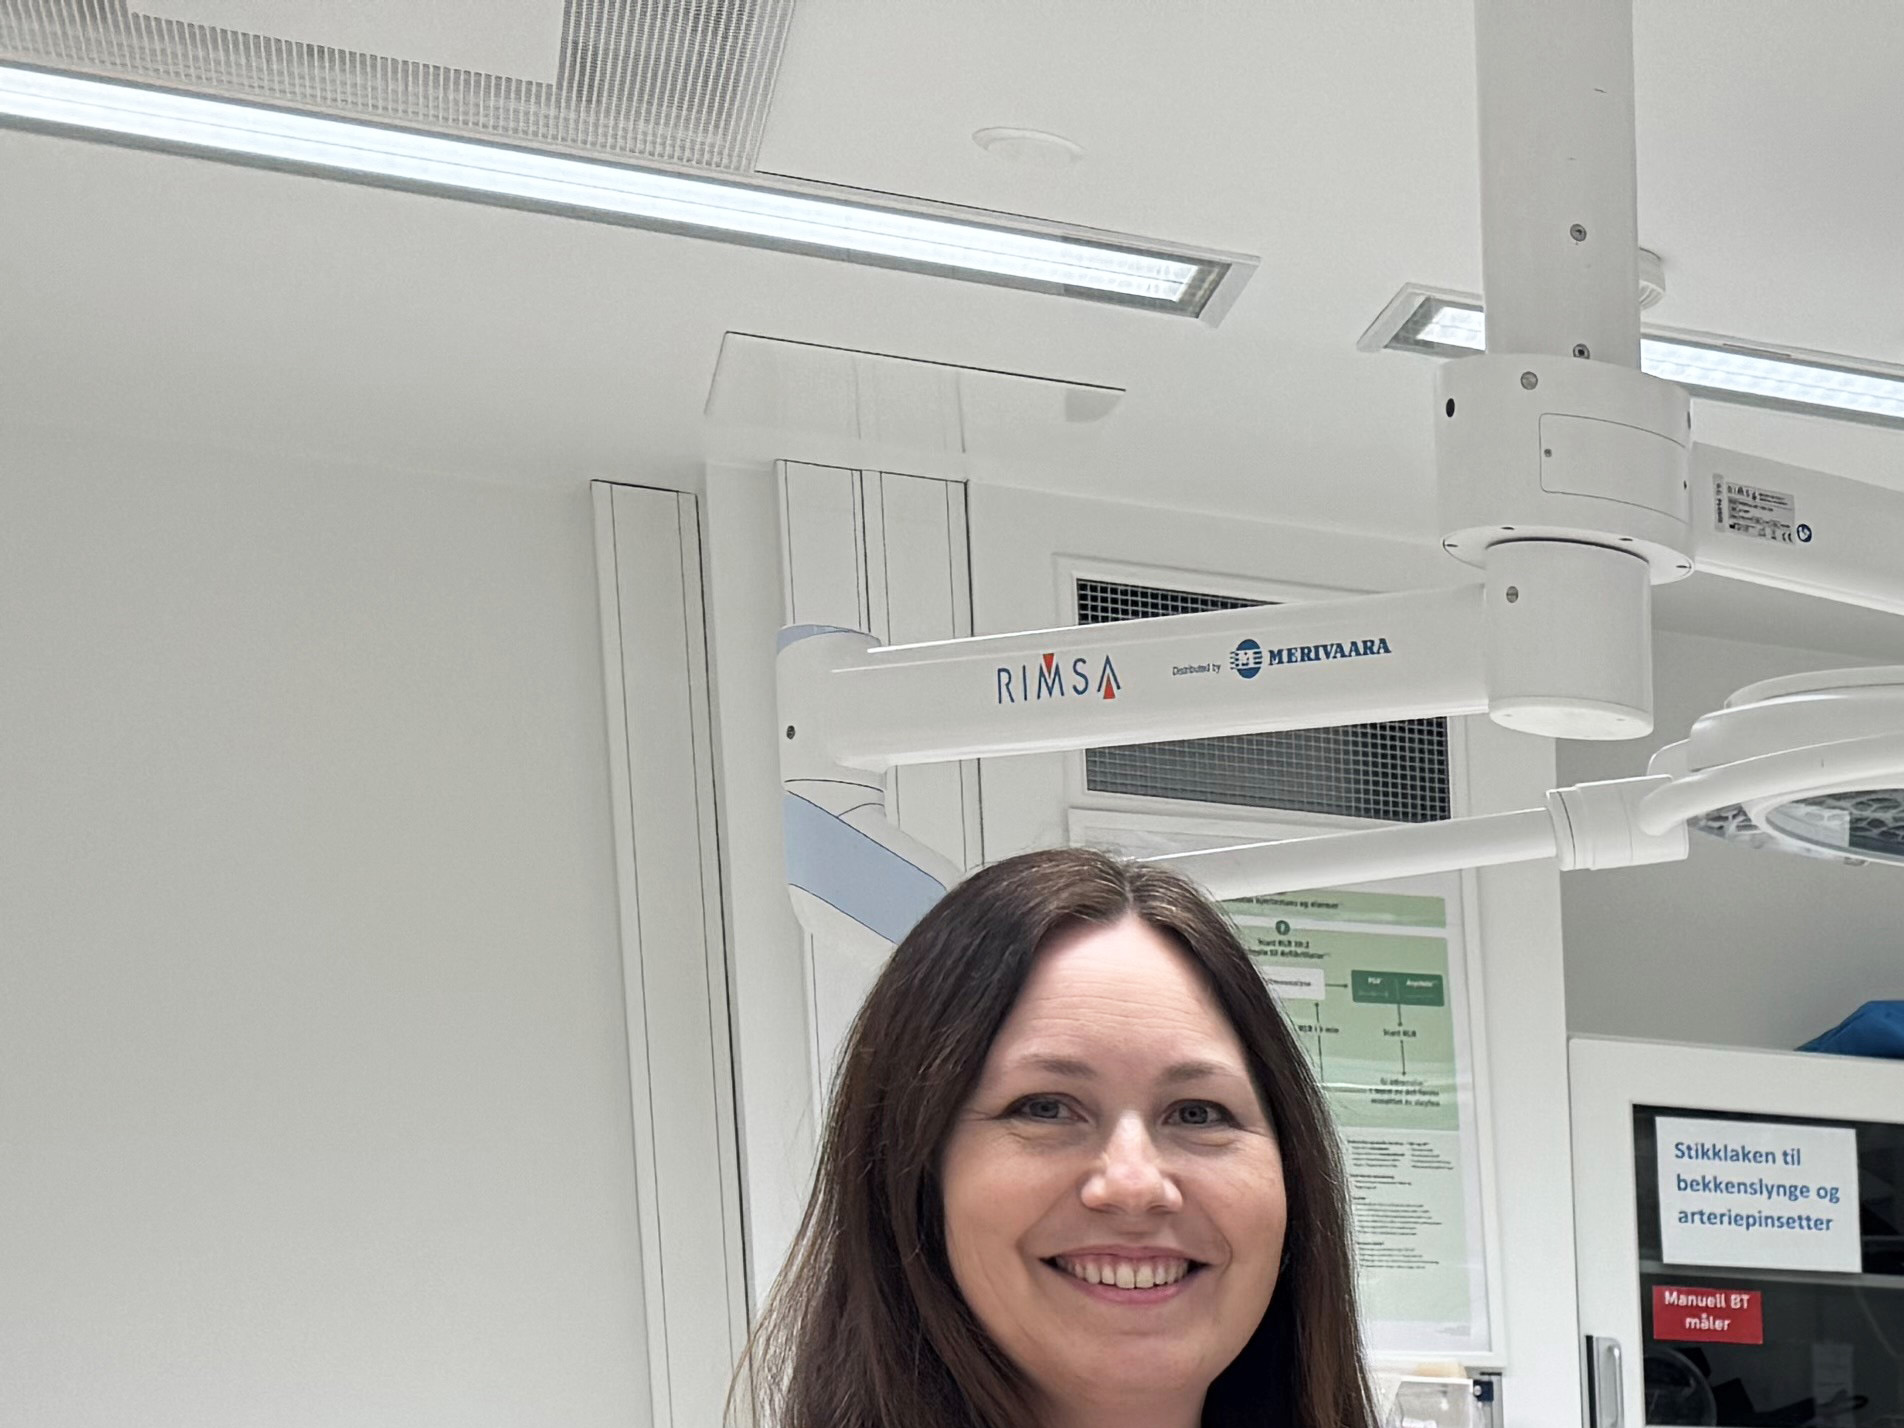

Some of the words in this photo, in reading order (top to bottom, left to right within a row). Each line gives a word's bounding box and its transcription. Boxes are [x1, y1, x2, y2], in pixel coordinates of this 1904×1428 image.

[1268, 637, 1391, 666] MERIVAARA
[997, 653, 1122, 704] RIMSA
[1674, 1142, 1777, 1164] Stikklaken
[1782, 1148, 1801, 1166] til
[1677, 1173, 1811, 1201] bekkenslynge
[1816, 1186, 1840, 1204] og
[1678, 1209, 1834, 1231] arteriepinsetter
[1664, 1290, 1726, 1308] Manuell
[1730, 1294, 1751, 1309] BT
[1685, 1312, 1731, 1331] måler
